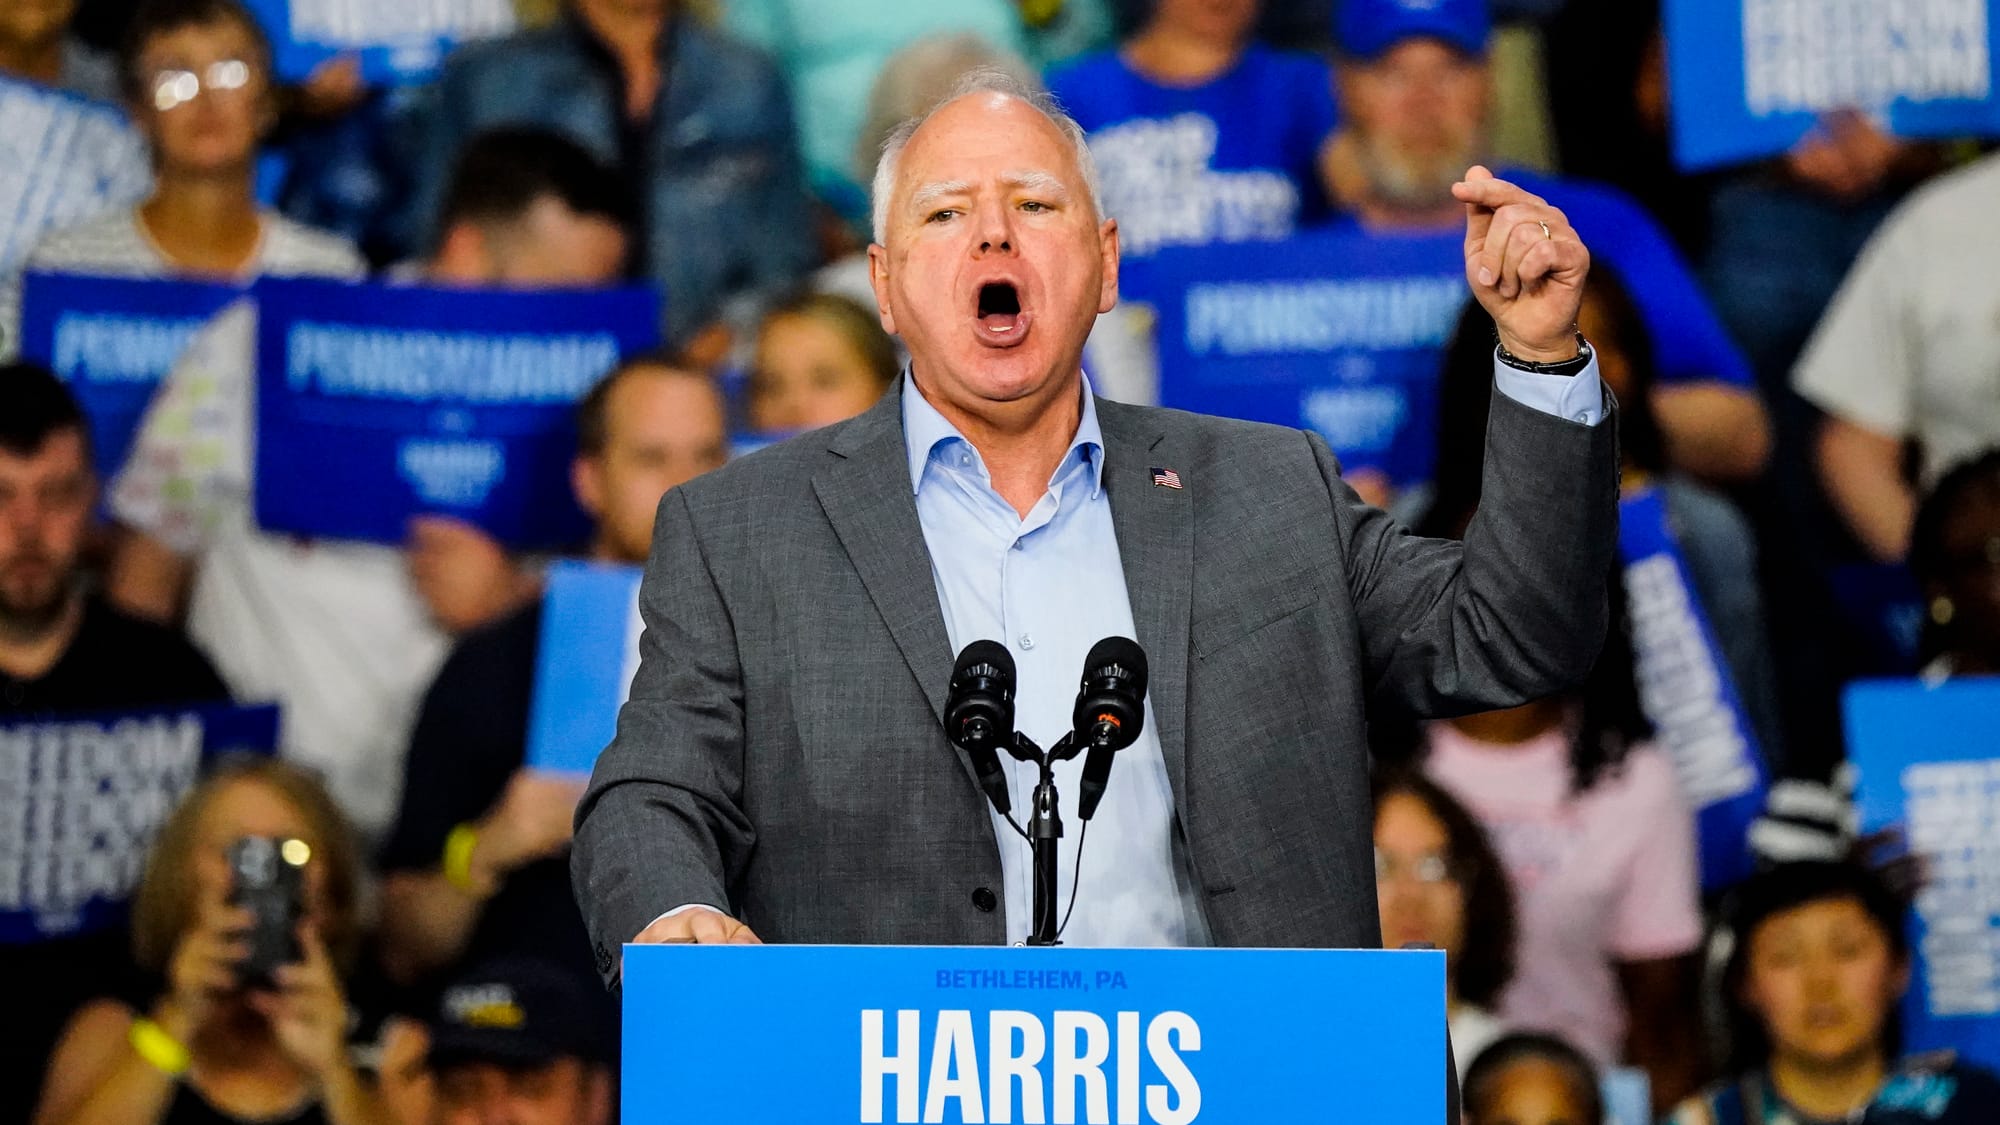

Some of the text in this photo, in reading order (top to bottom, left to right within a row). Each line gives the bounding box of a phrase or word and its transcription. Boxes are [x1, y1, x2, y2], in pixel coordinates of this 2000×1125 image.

[936, 970, 1128, 992] BETHLEHEM, PA
[860, 1009, 1201, 1125] HARRIS
